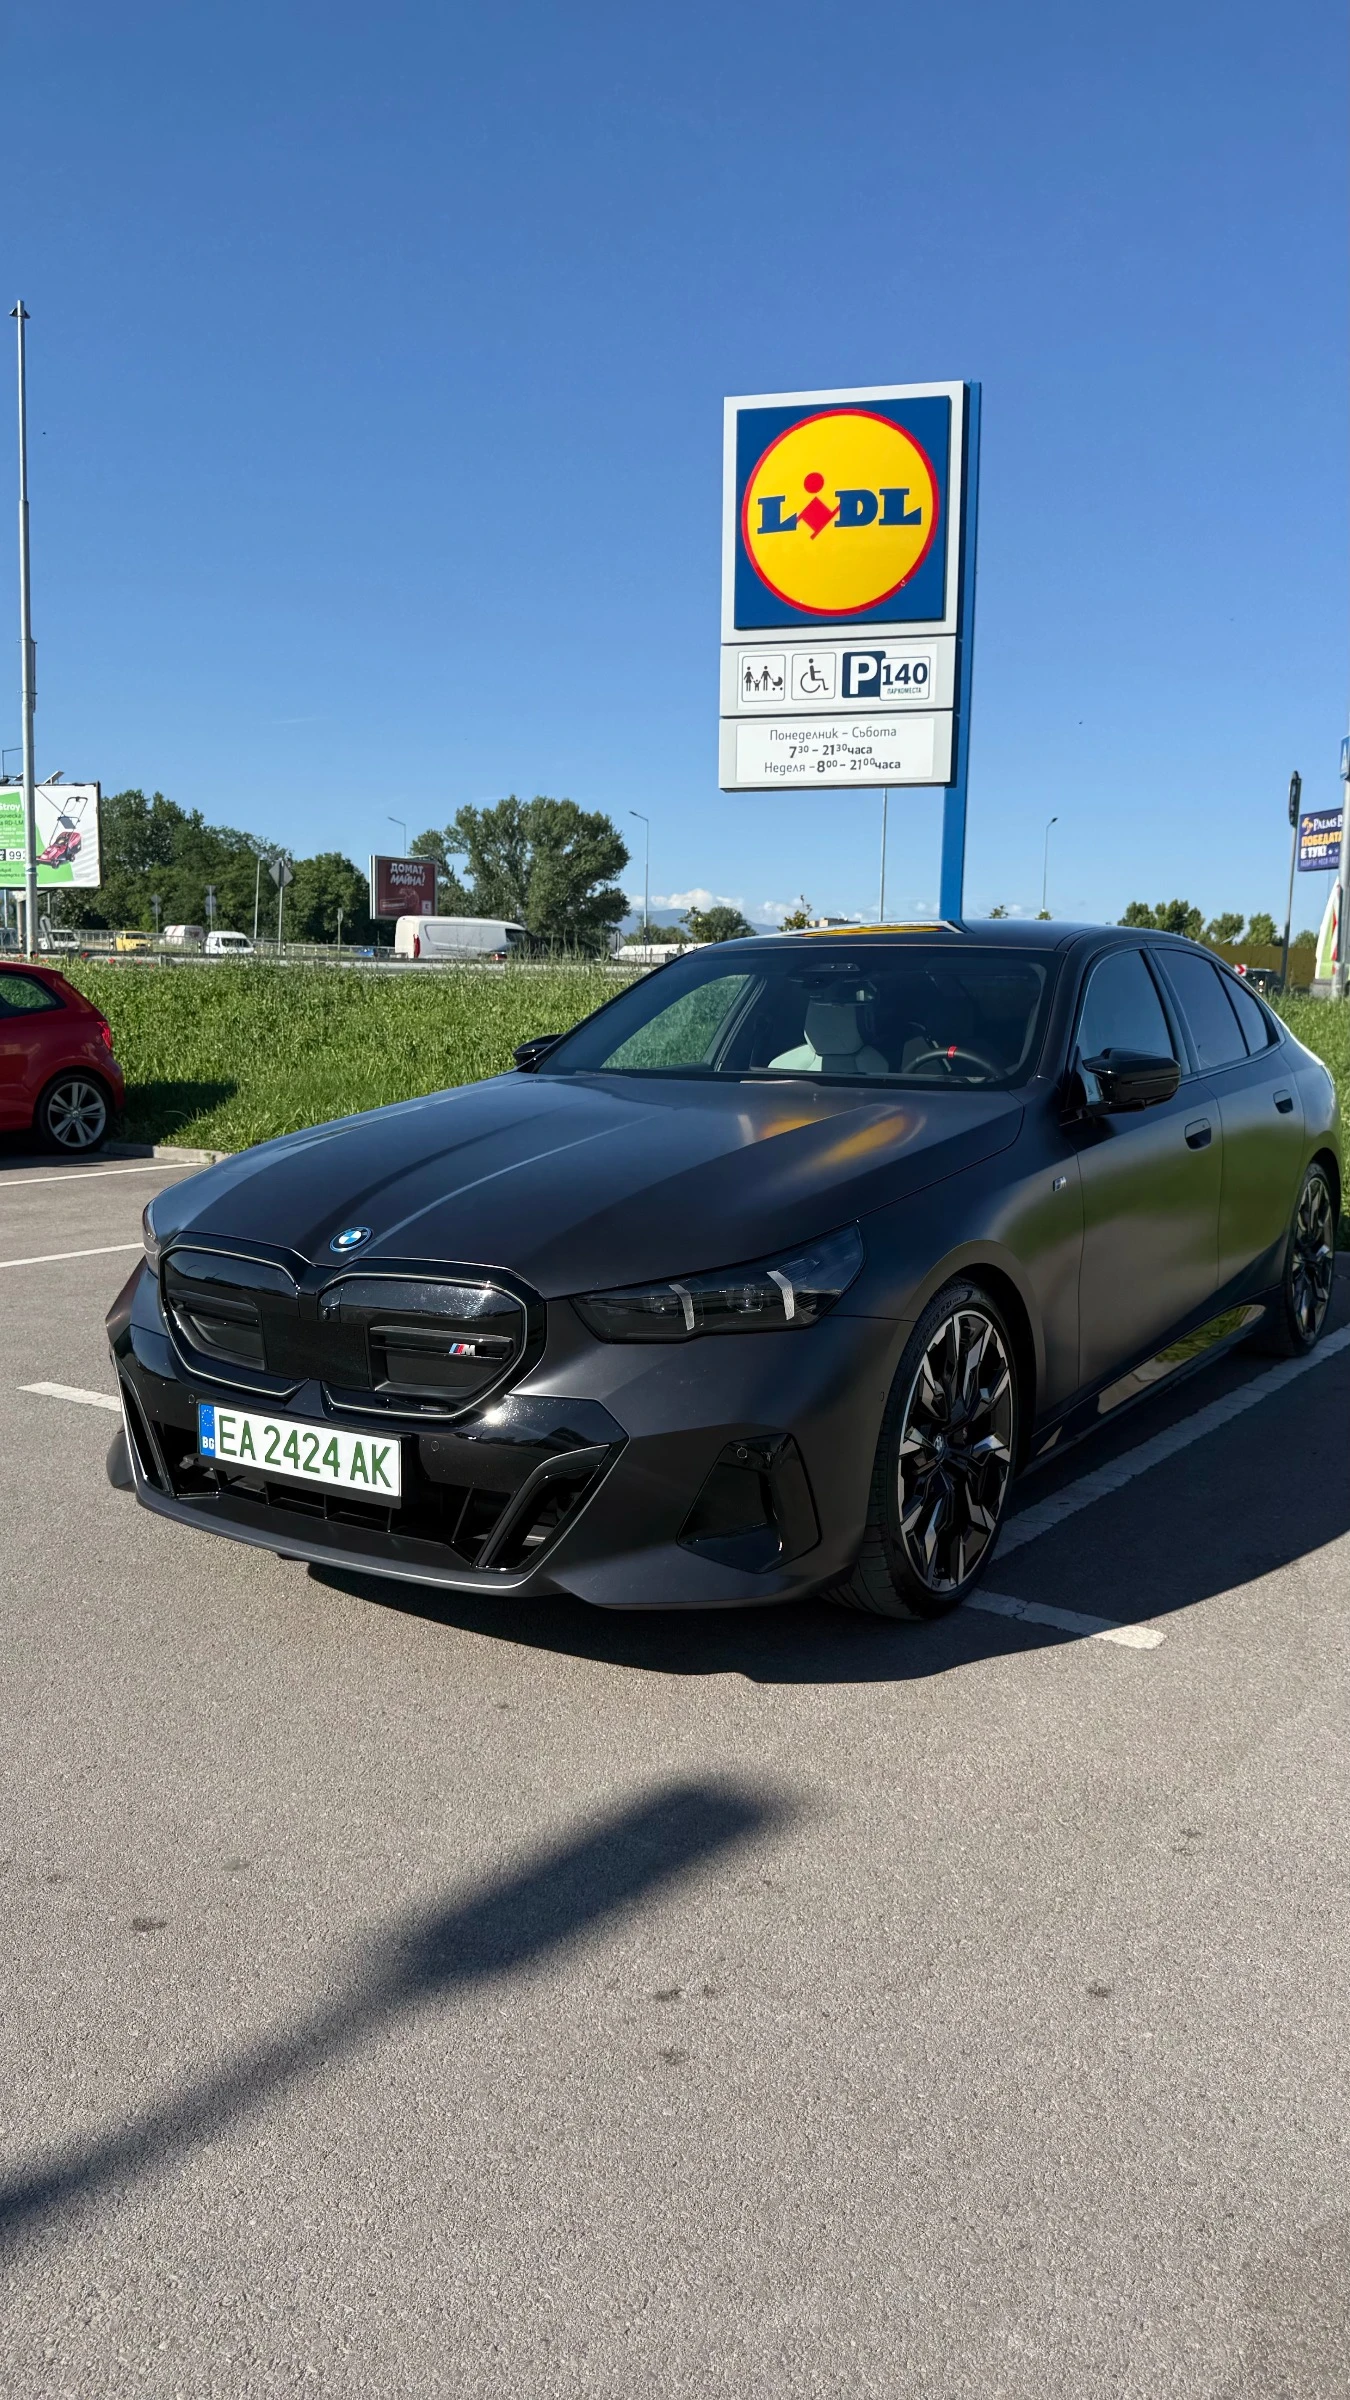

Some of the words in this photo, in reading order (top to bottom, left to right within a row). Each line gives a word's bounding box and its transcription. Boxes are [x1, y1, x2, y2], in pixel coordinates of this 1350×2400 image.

[850, 655, 878, 695] P
[882, 662, 928, 685] 140
[770, 728, 838, 743] Понеделник
[852, 726, 897, 738] Събота
[764, 762, 806, 776] Неделя
[1313, 817, 1337, 831] PALMS
[1338, 814, 1343, 828] B
[390, 872, 426, 887] МАЙНА!
[202, 1436, 215, 1449] BG
[219, 1414, 256, 1460] EA
[263, 1425, 341, 1477] 2424
[349, 1440, 392, 1488] AK
